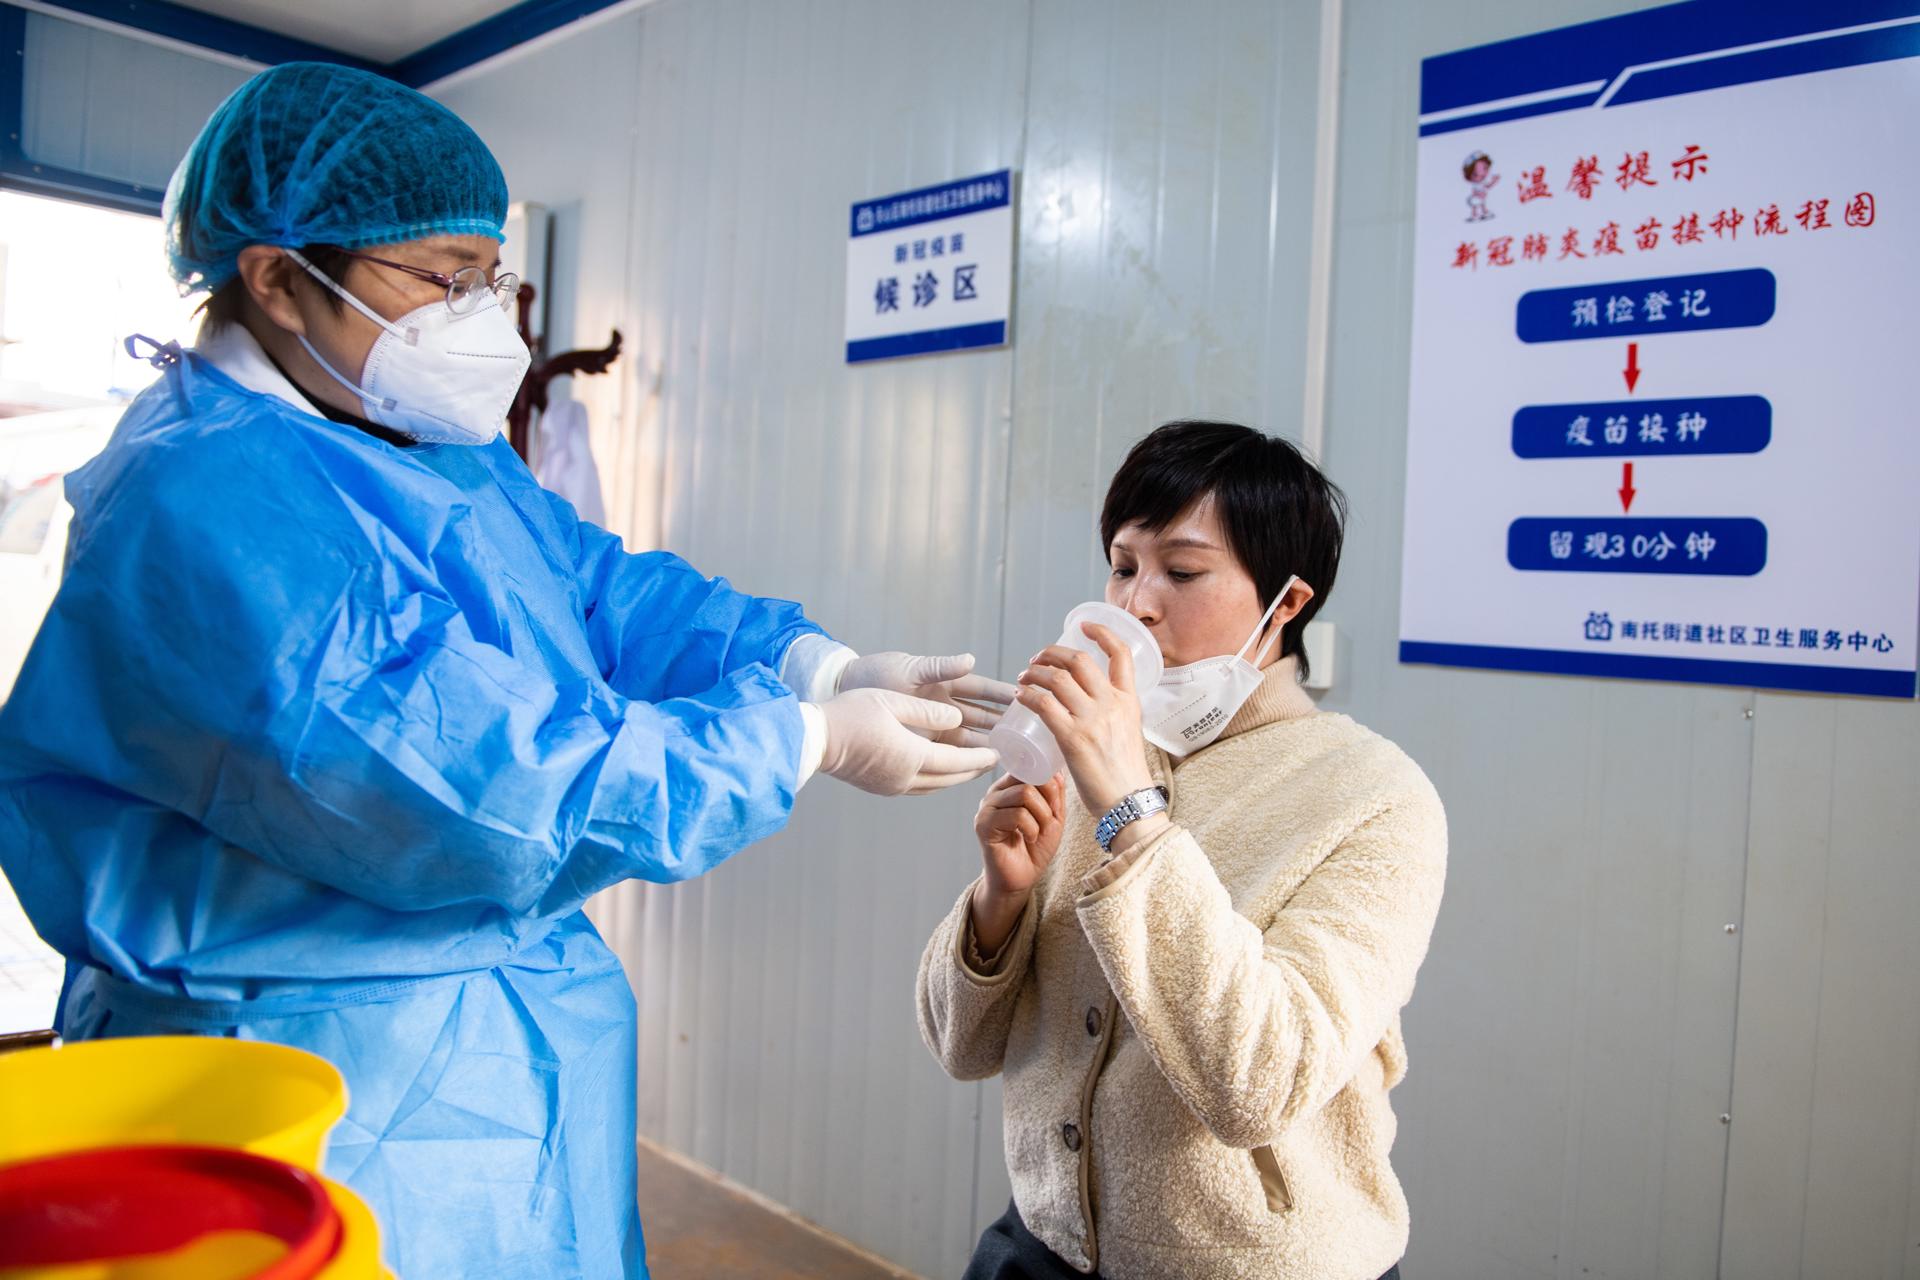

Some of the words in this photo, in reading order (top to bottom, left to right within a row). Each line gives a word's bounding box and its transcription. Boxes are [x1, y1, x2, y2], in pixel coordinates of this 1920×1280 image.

[1518, 144, 1709, 204] 温馨提示
[895, 233, 964, 263] 新冠疫苗
[1451, 191, 1876, 270] 新冠肺炎疫苗接种流程图
[875, 265, 978, 314] 候诊区
[1571, 289, 1711, 327] 预检登记
[1566, 412, 1707, 446] 疫苗接种
[1550, 531, 1716, 560] 留观30分钟
[1620, 621, 1895, 653] 南托街道社区卫生服务中心
